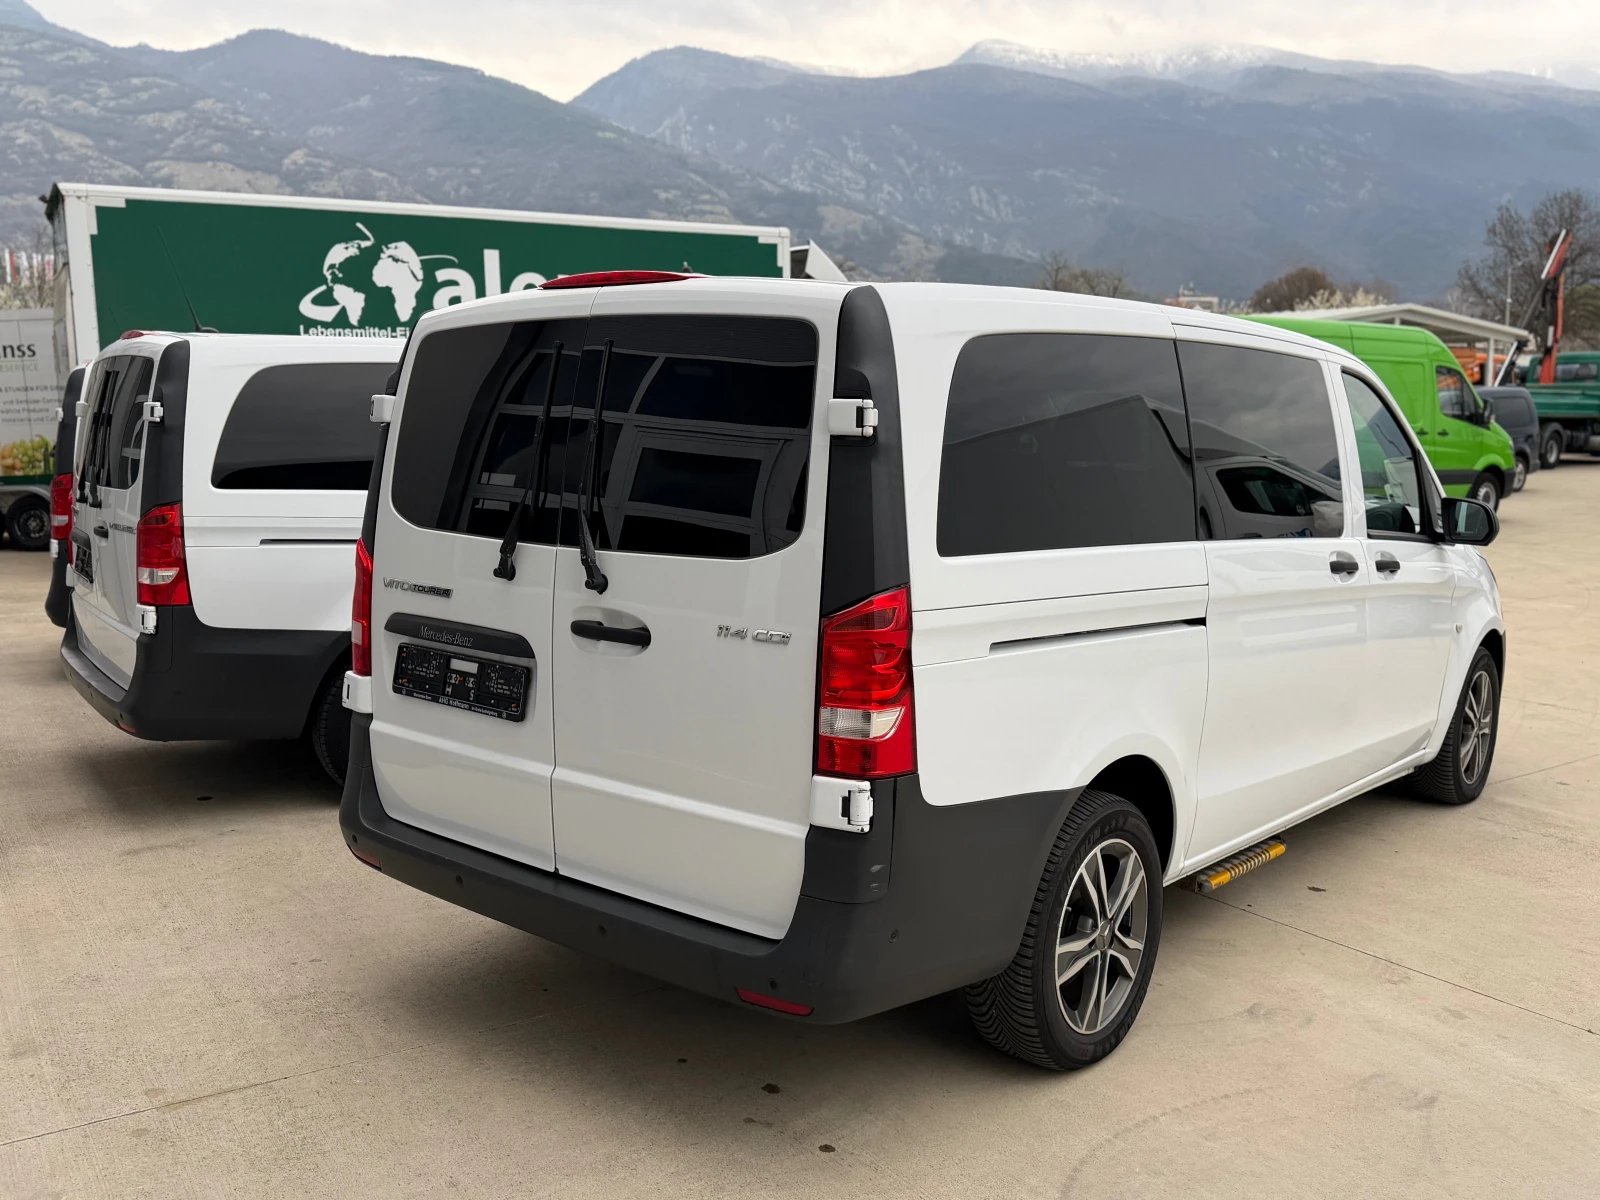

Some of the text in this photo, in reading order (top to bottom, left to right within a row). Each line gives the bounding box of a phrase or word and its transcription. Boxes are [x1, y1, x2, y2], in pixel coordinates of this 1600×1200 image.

[383, 577, 453, 599] VITO TOURER
[419, 625, 474, 647] Mercedes-Benz
[717, 624, 748, 640] 114
